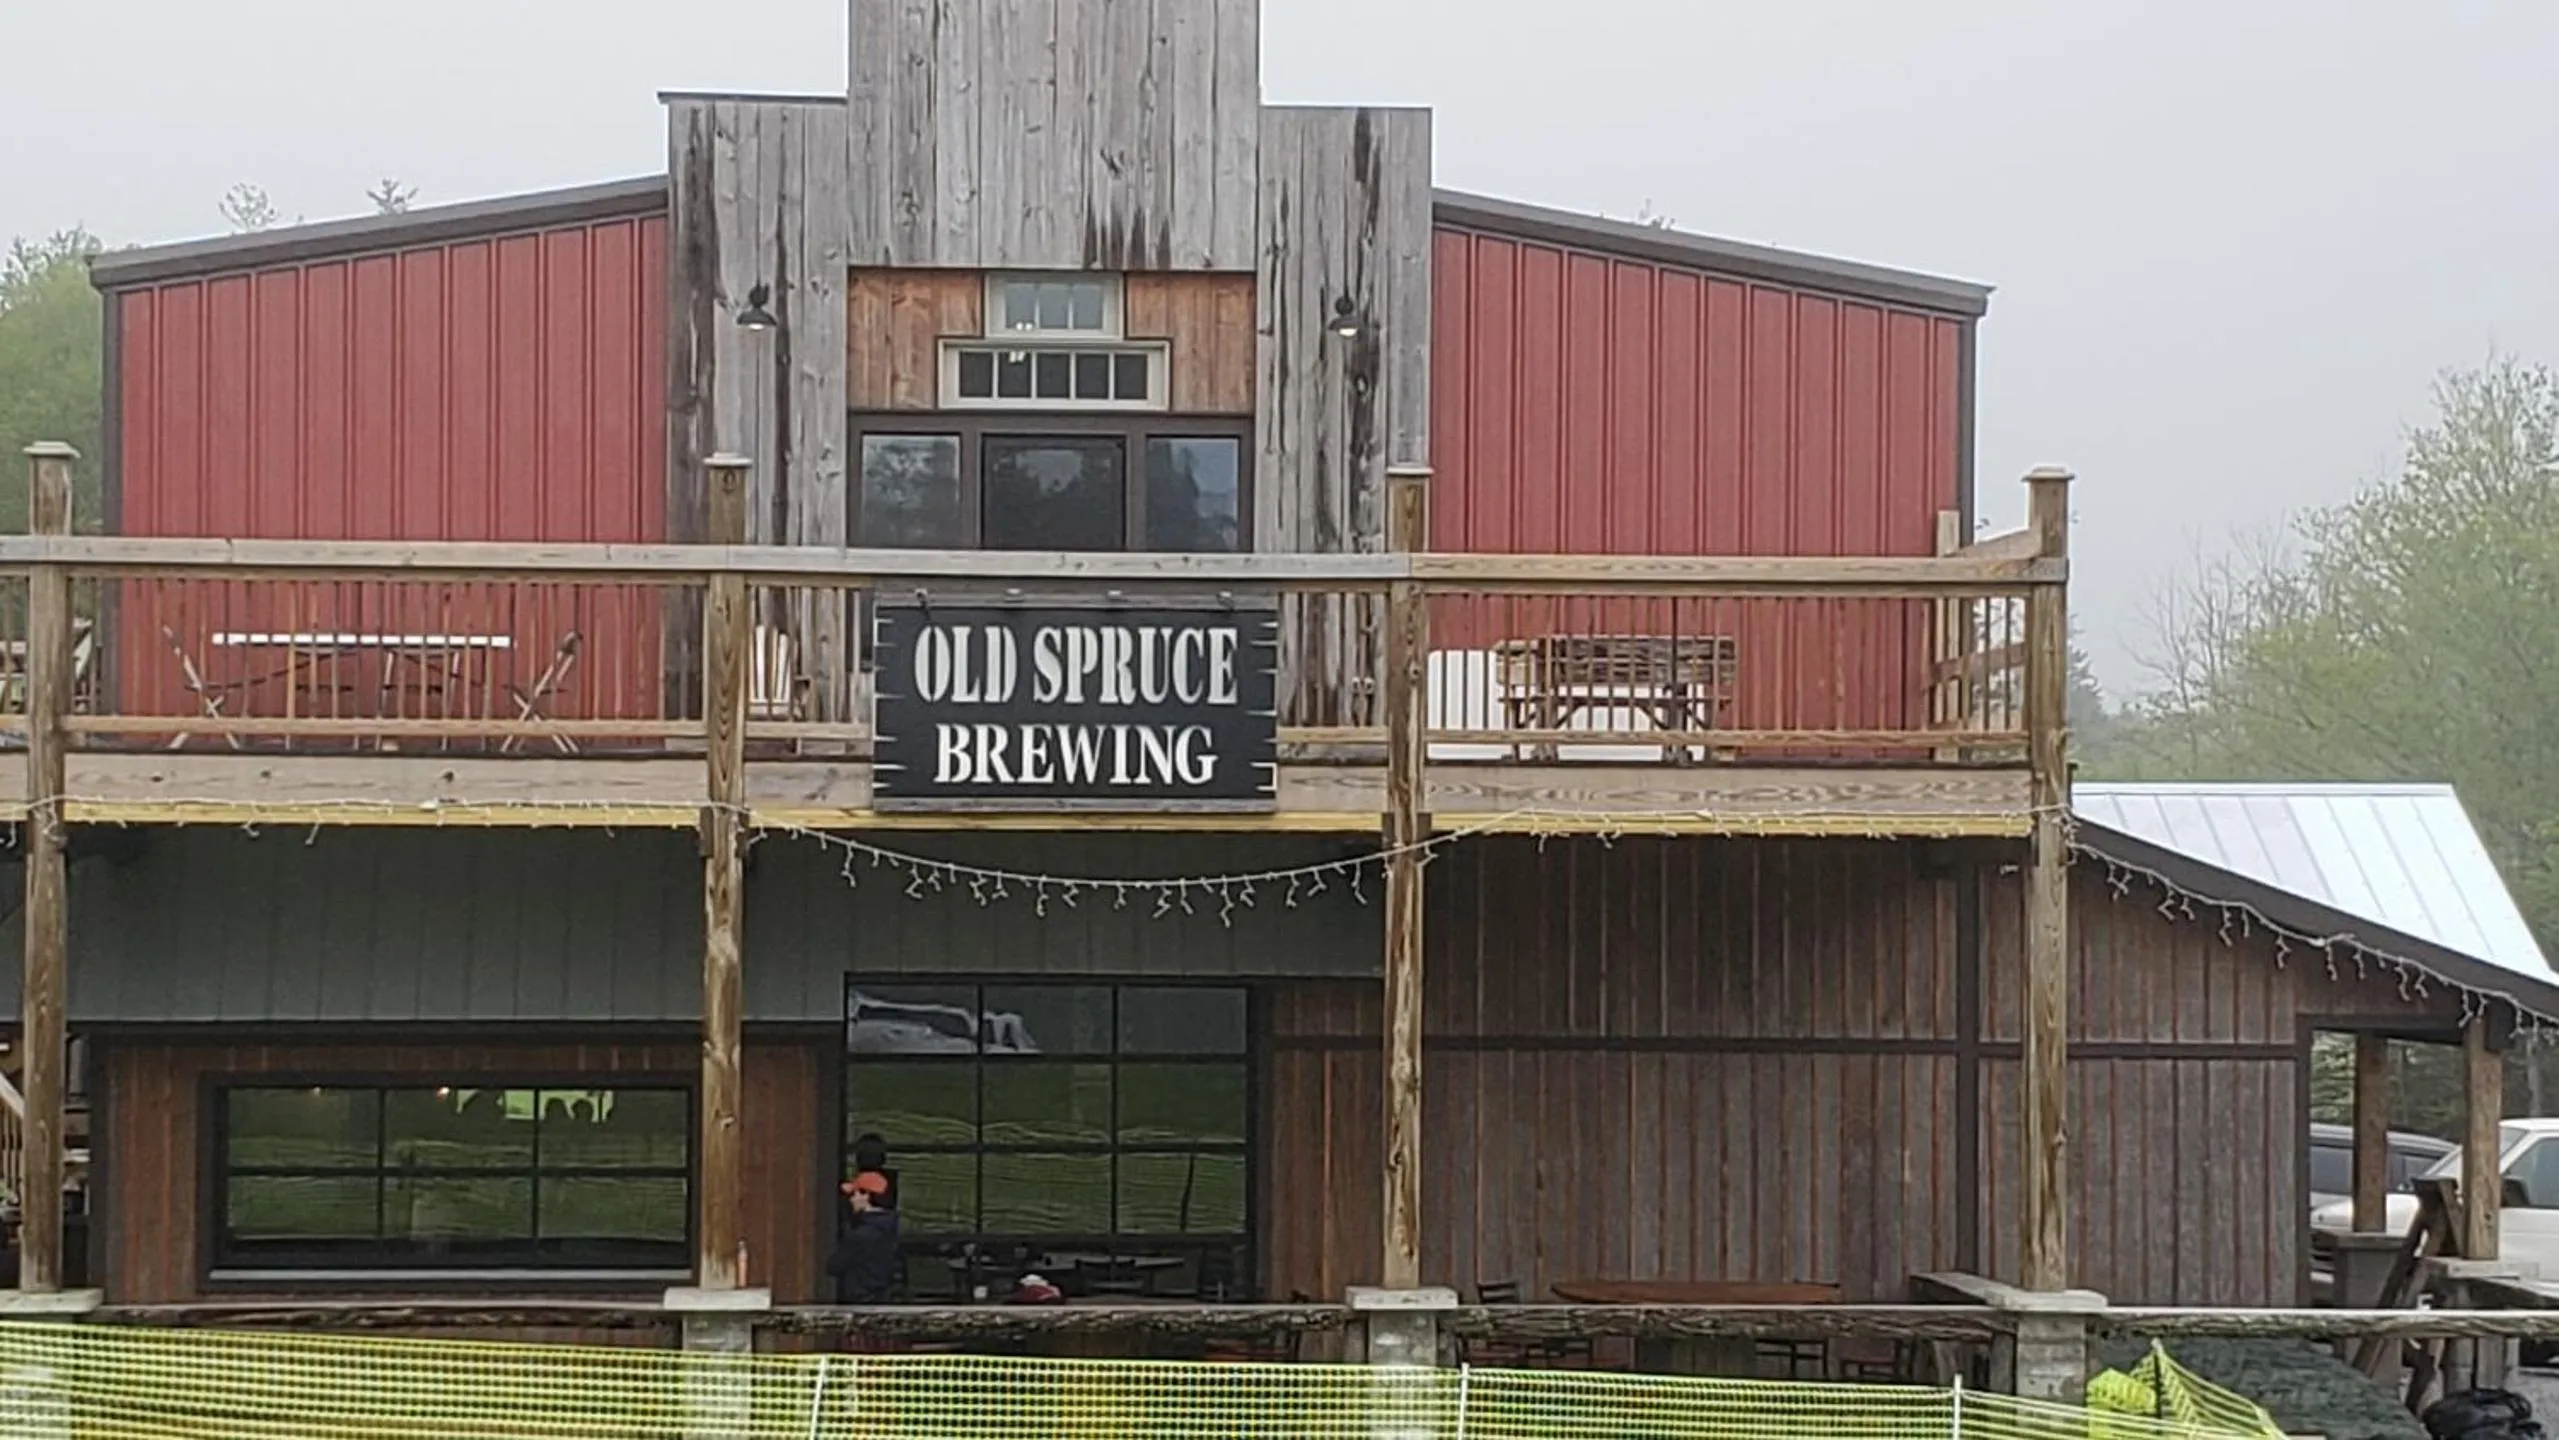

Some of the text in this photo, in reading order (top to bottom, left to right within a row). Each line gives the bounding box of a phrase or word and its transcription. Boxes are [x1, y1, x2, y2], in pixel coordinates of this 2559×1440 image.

[914, 625, 1238, 705] OLD SPRUCE
[933, 723, 1219, 785] BREWING
